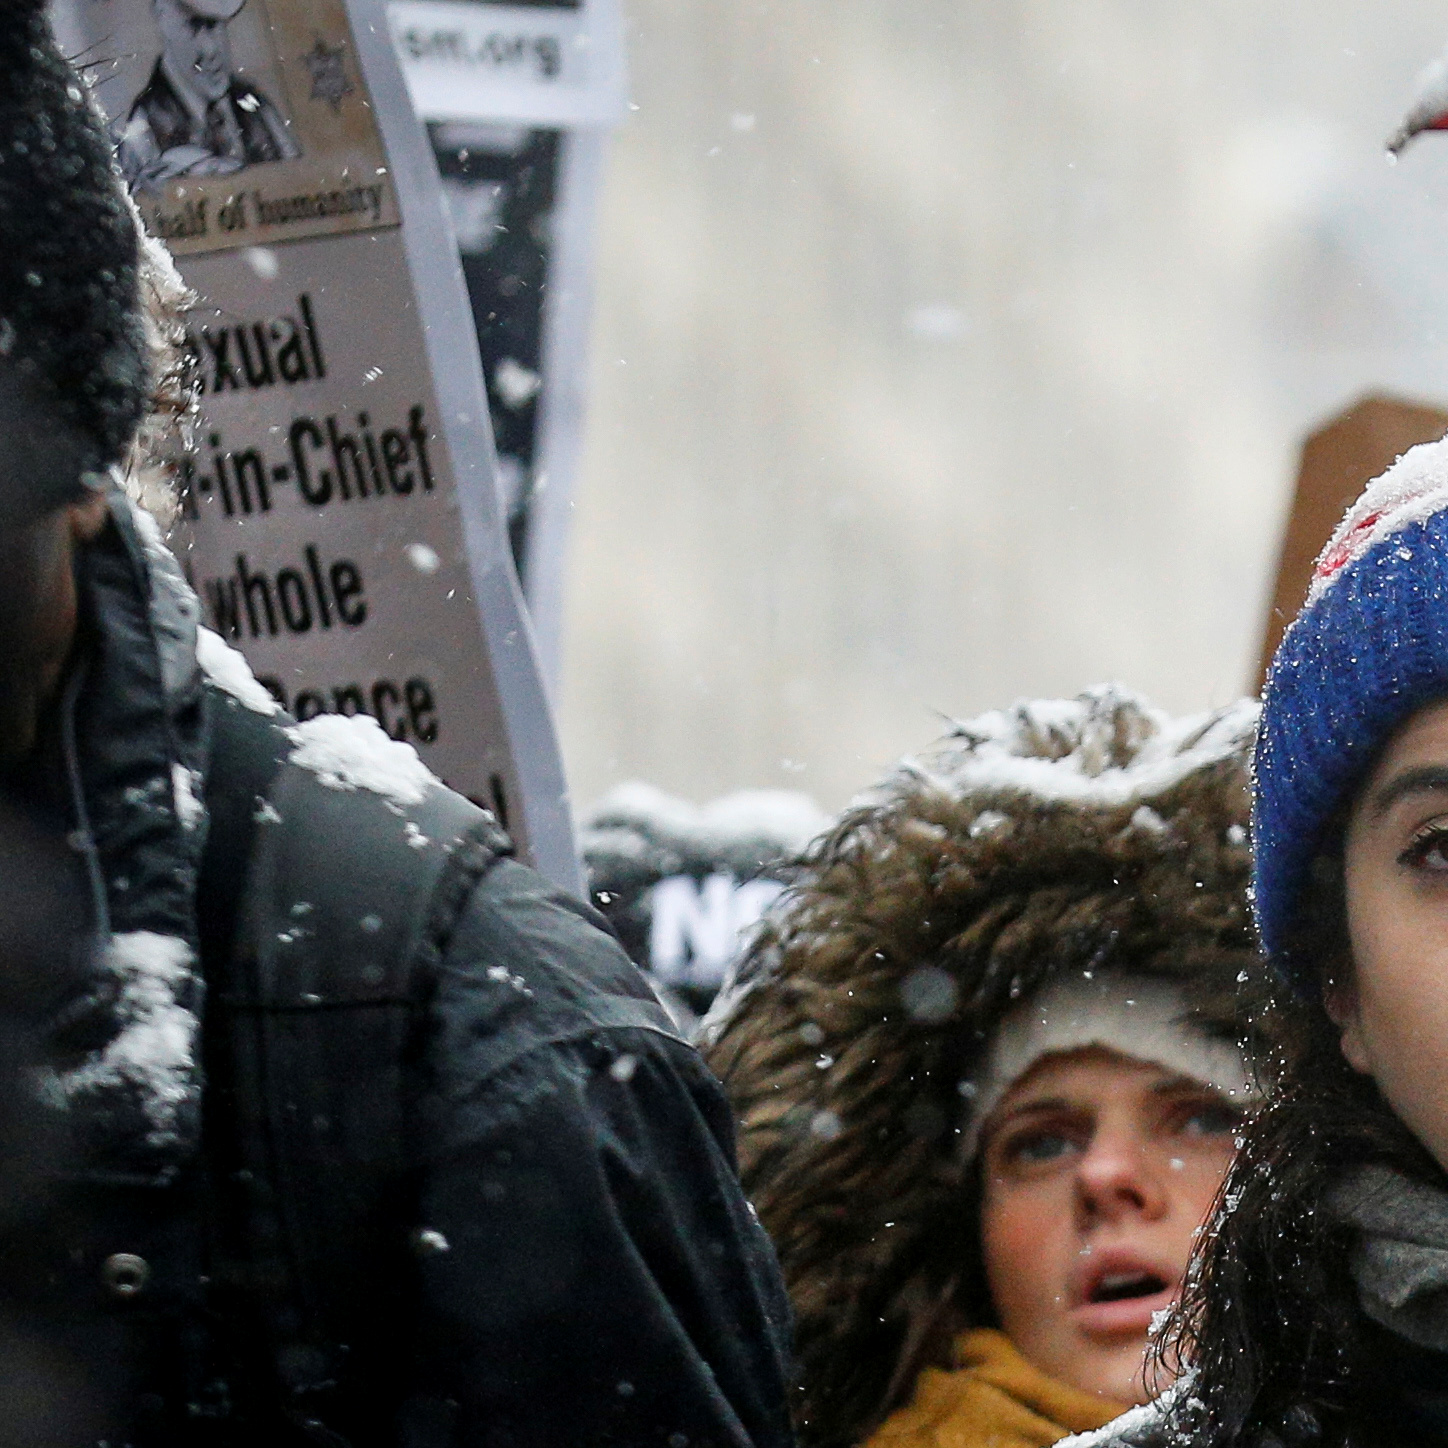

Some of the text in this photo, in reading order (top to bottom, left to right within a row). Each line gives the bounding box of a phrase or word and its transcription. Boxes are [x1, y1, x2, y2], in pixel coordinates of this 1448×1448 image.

[218, 190, 246, 233] of
[253, 183, 382, 225] humanity
[206, 543, 369, 641] whole
